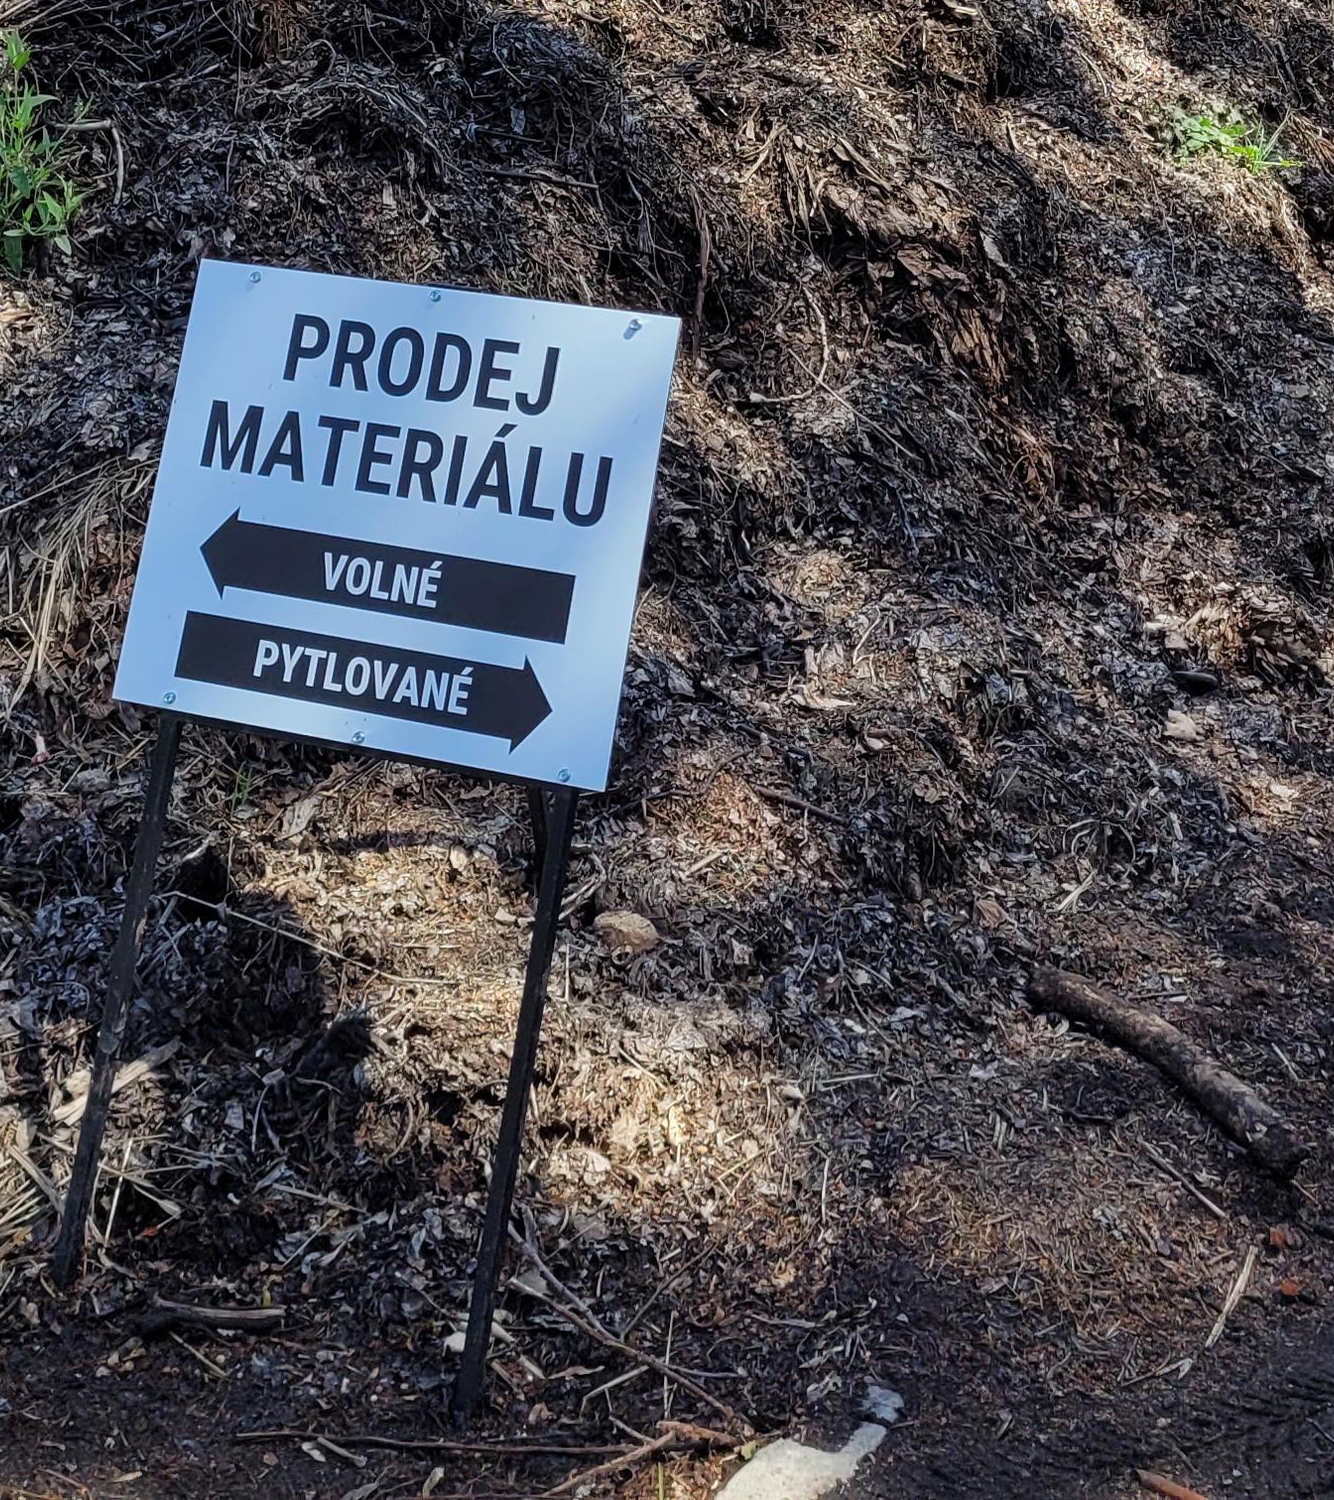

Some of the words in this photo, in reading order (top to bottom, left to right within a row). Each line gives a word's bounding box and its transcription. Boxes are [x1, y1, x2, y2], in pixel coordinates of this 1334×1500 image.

[282, 313, 562, 417] PRODEJ
[199, 400, 614, 528] MATERIÁLU
[323, 551, 443, 610] VOLNÉ
[252, 639, 475, 717] PYTLOVANÉ
